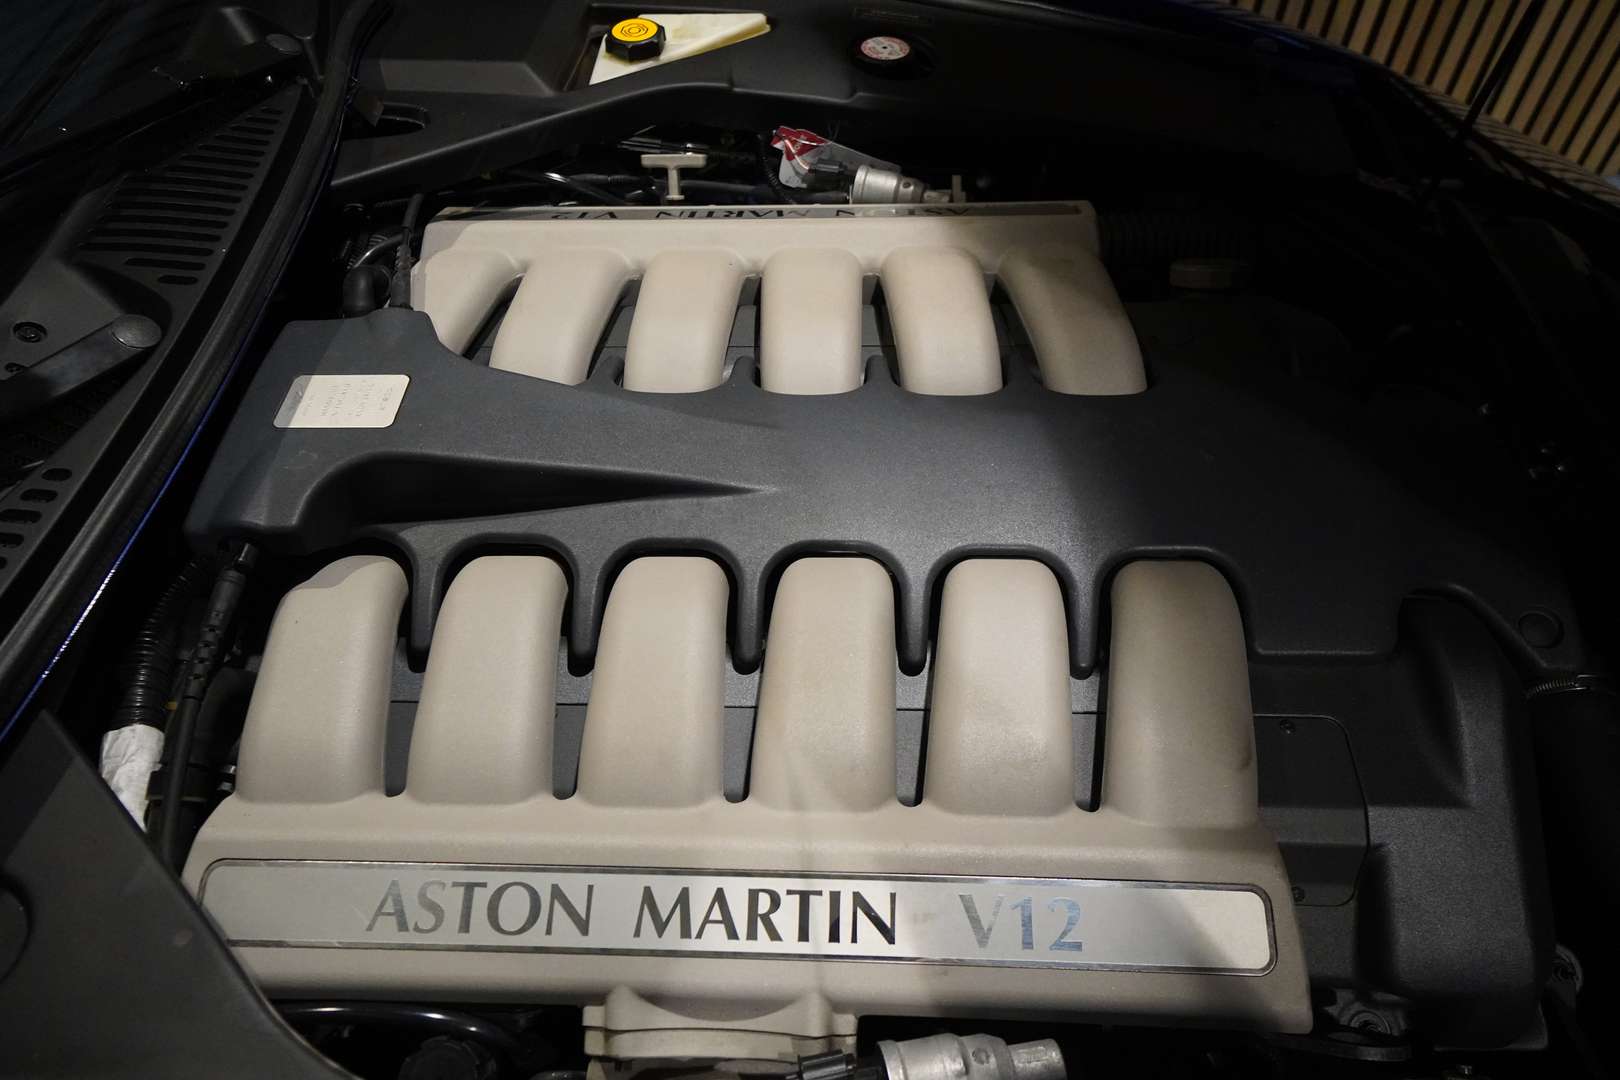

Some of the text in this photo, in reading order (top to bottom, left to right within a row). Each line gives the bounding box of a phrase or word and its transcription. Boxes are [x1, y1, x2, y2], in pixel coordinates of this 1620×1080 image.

[551, 208, 969, 219] ASTN MARTIN V12
[366, 879, 1084, 952] ASTON MARTIN V12
